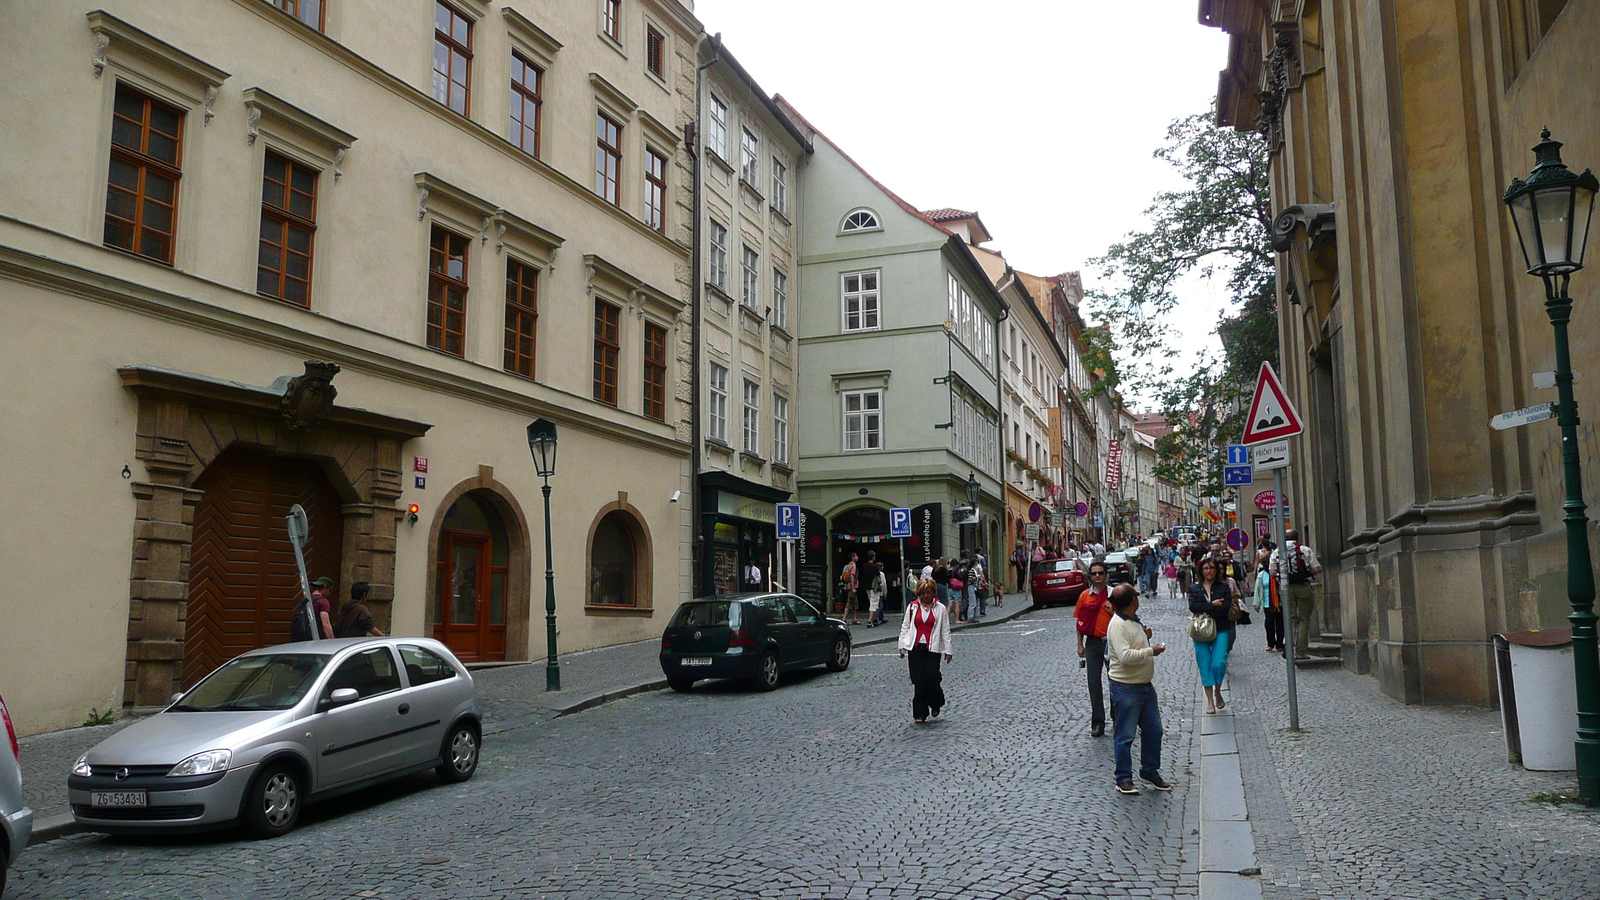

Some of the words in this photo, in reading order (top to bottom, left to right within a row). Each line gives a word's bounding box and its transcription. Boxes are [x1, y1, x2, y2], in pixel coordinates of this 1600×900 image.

[1106, 441, 1118, 482] PIZZERIA
[418, 478, 424, 486] 15
[783, 507, 792, 526] P
[894, 511, 907, 528] P
[97, 793, 109, 805] ZG
[114, 793, 145, 805] 5343-U
